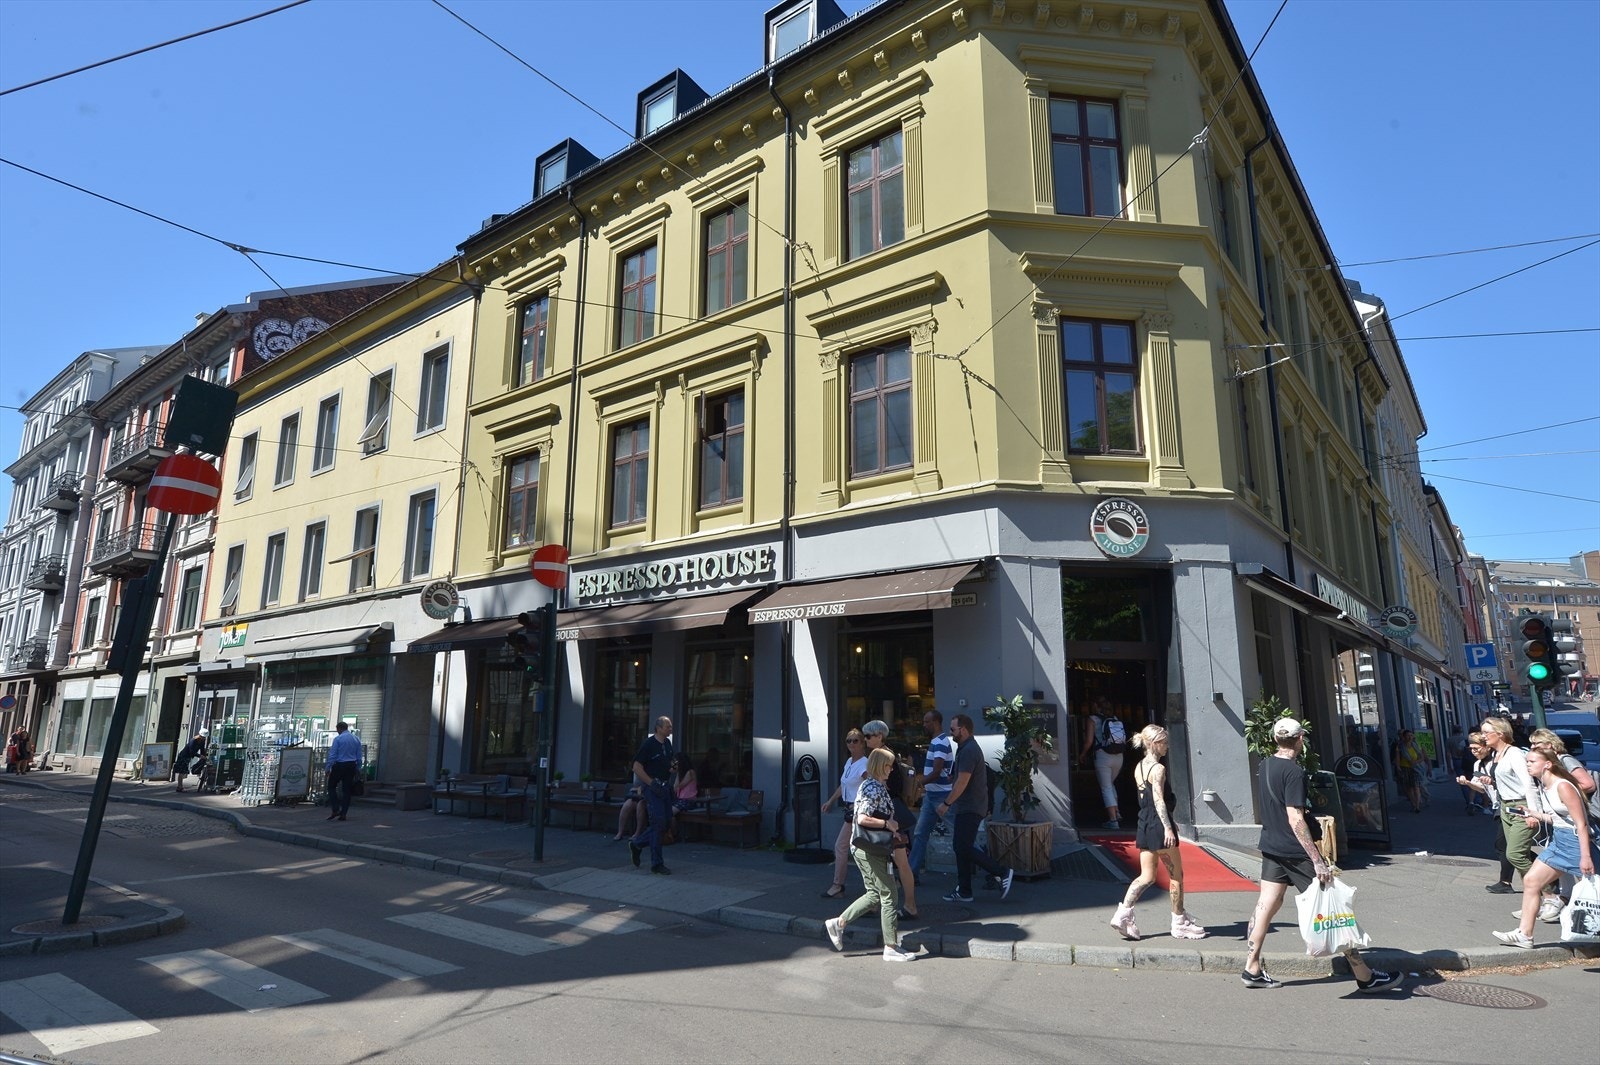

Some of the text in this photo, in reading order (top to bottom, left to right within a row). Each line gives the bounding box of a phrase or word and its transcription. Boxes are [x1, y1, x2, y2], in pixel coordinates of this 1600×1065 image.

[1096, 501, 1144, 524] ESPRESSO
[1103, 538, 1140, 554] HOUSE
[575, 545, 772, 599] ESPRESSO HOUSE
[427, 583, 457, 599] ESPRESSO
[429, 606, 454, 617] HOUSE
[753, 603, 846, 622] ESPRESSO HOUSE
[1381, 606, 1415, 621] ESPRESSO
[556, 629, 579, 640] HOUSE
[1386, 627, 1413, 637] HOUSE
[1471, 646, 1488, 666] P
[1316, 911, 1352, 934] joker
